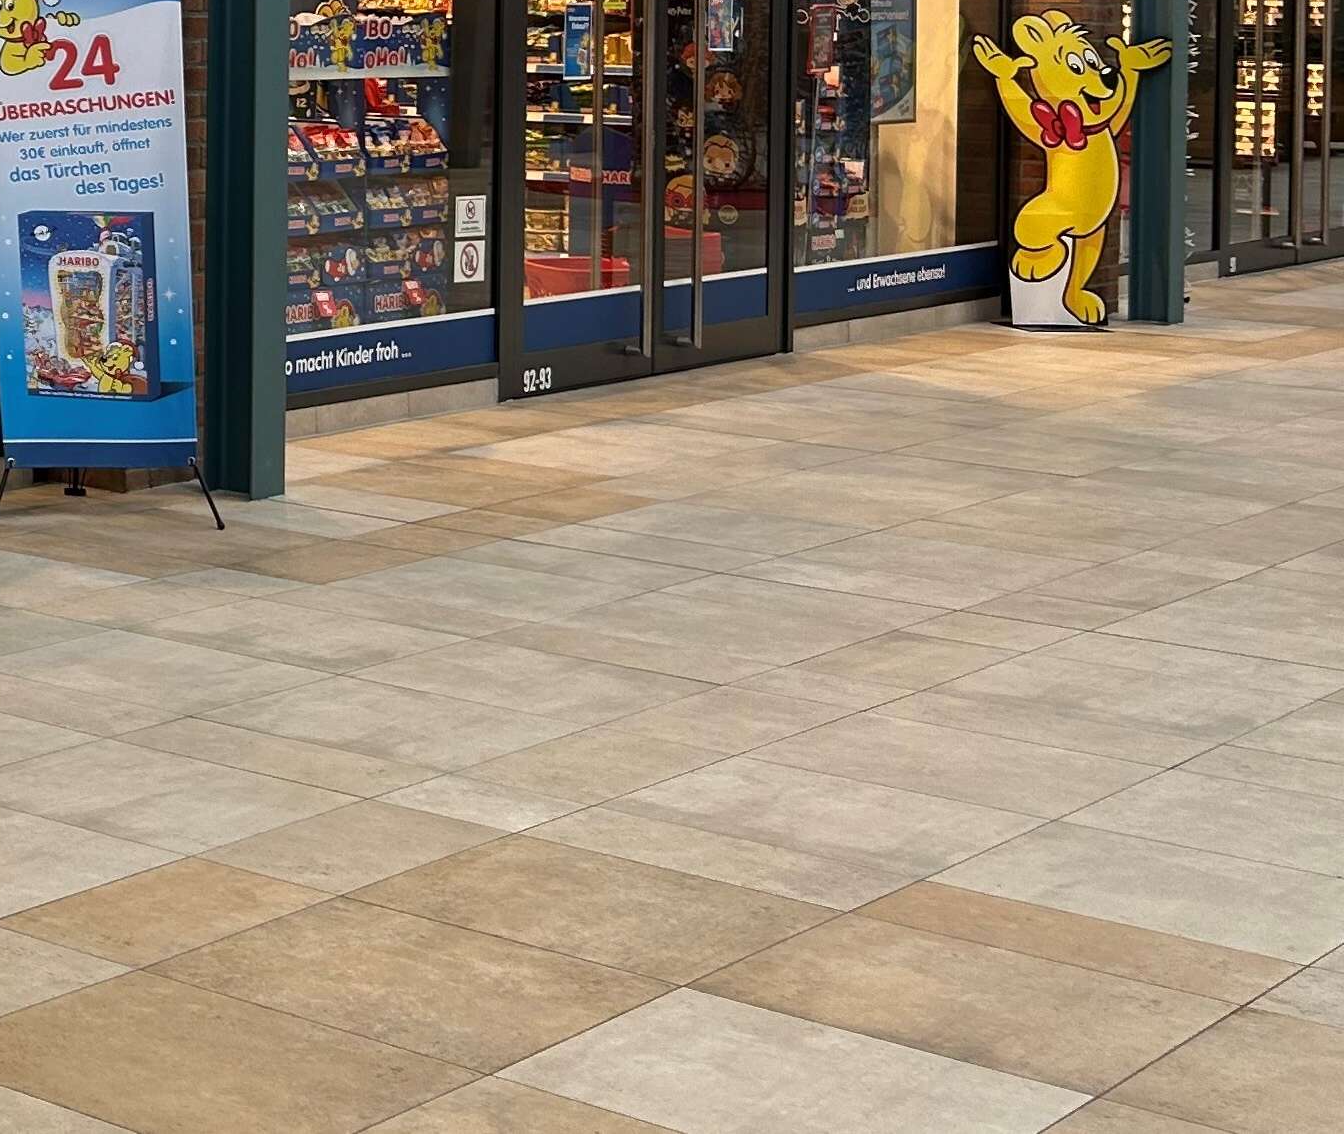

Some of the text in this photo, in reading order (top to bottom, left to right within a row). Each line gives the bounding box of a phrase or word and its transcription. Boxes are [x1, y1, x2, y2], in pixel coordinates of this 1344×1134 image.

[44, 33, 120, 91] 24
[28, 126, 70, 140] zuerst
[72, 123, 92, 137] für
[95, 116, 173, 135] mindestens
[19, 137, 151, 161] 30€ einkauft, öffnet
[9, 159, 112, 182] das Türchen
[75, 173, 165, 196] des Tages!
[56, 256, 100, 267] HARIBO
[856, 274, 872, 291] und
[872, 270, 916, 289] Erwachsene
[916, 264, 946, 282] ebenso!
[295, 351, 334, 374] macht
[335, 345, 375, 368] Kinder
[375, 340, 399, 362] froh
[522, 367, 553, 394] 92-93
